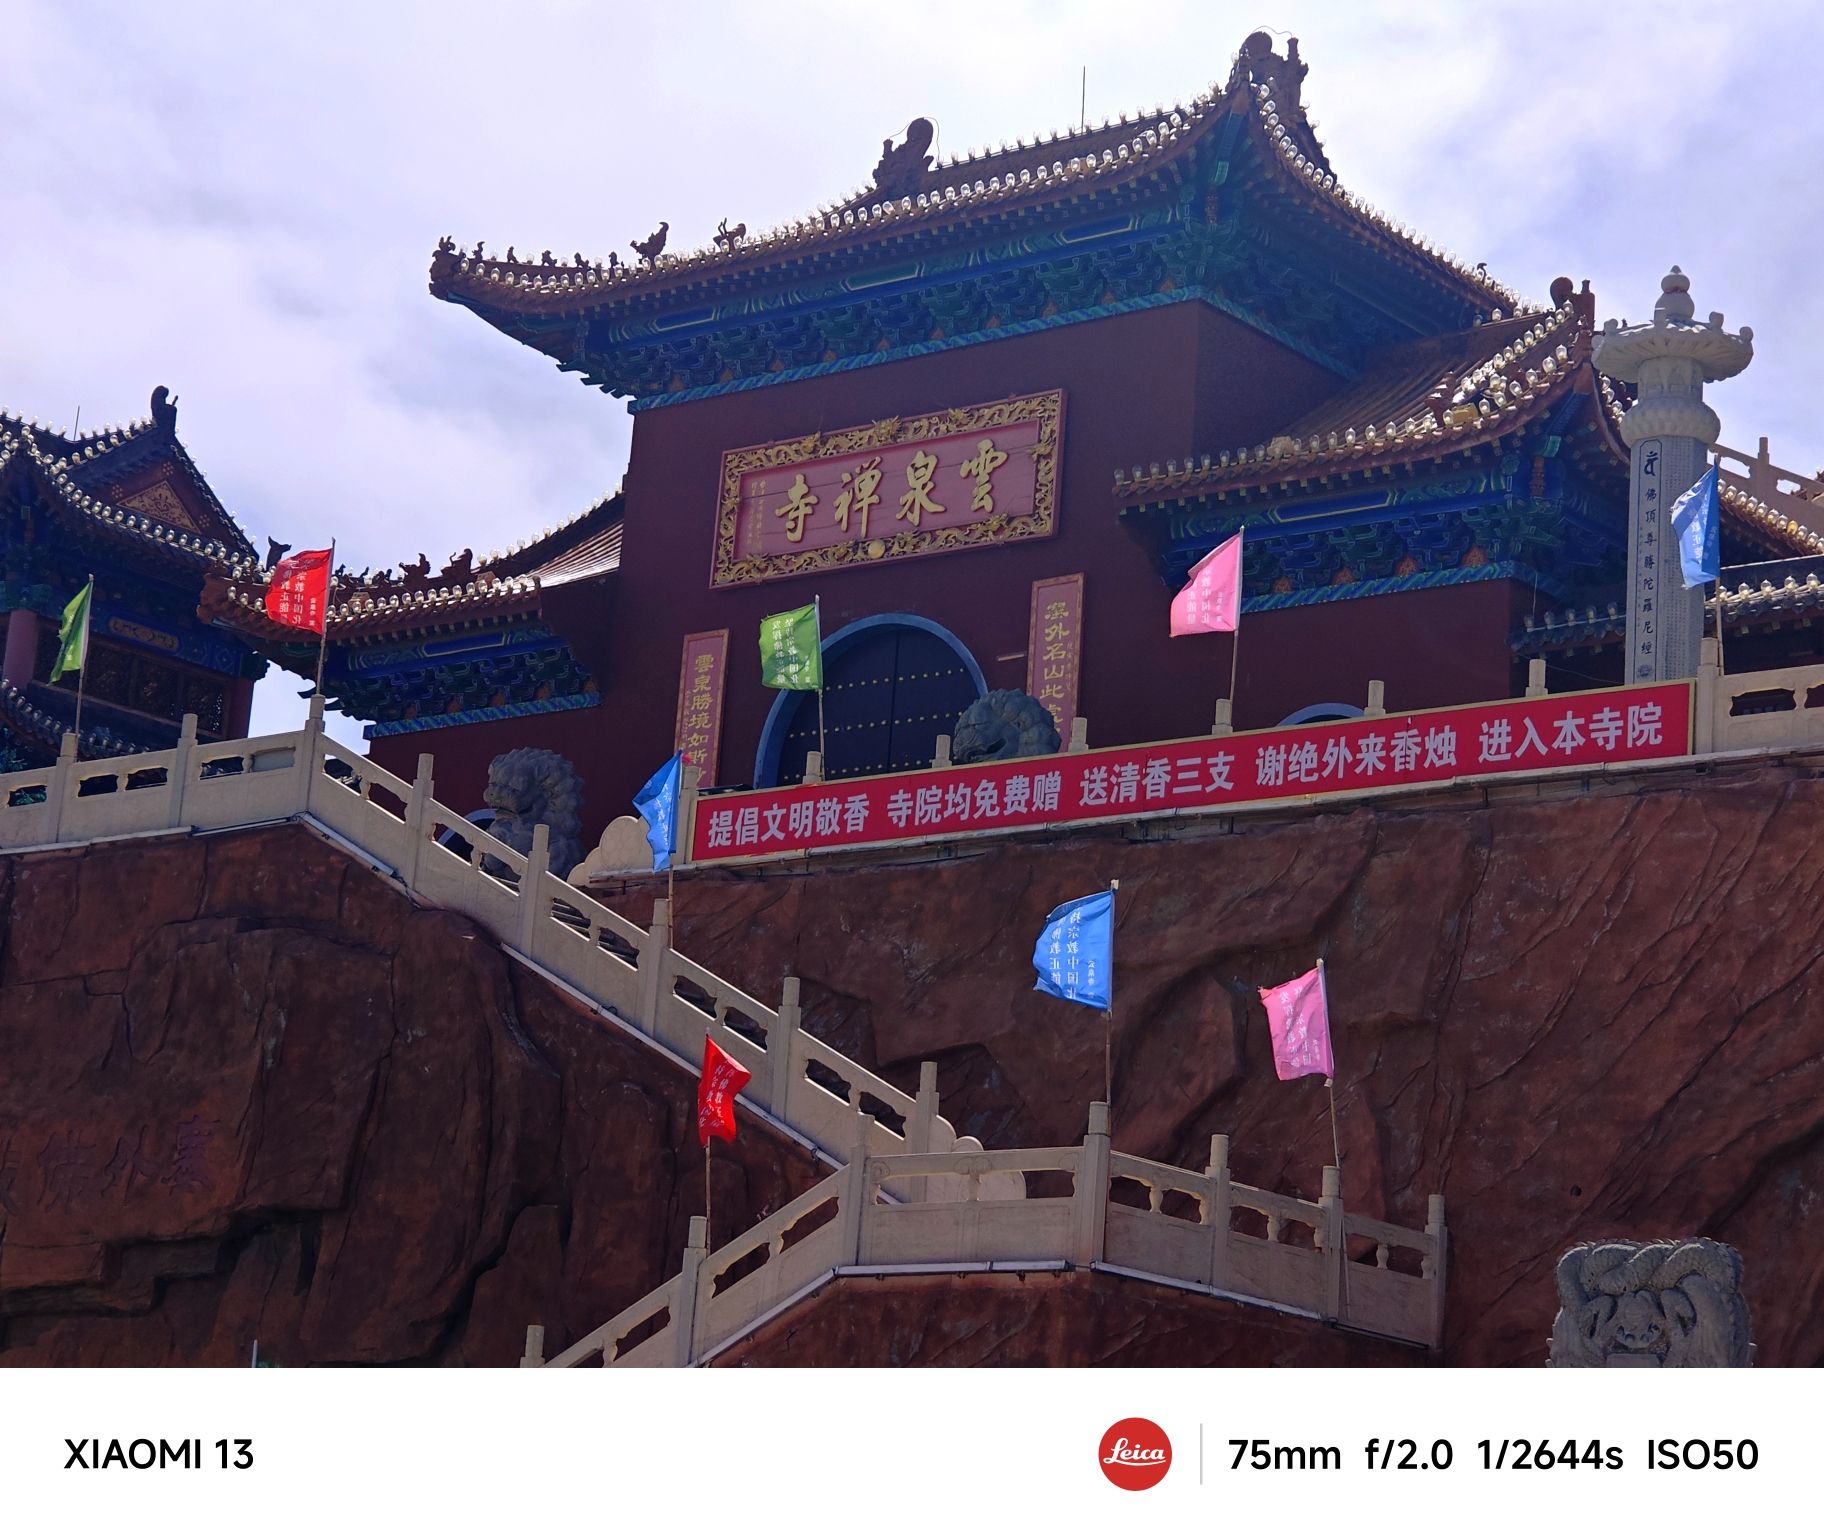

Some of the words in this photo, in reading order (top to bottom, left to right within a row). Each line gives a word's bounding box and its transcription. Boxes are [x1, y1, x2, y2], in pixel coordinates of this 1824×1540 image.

[708, 789, 870, 848] 提倡文明敬香
[886, 770, 1061, 828] 寺院均免费赠
[1079, 751, 1235, 807] 送清香三支
[1255, 725, 1457, 786] 谢绝外来香烛
[1478, 702, 1663, 763] 进入本寺院
